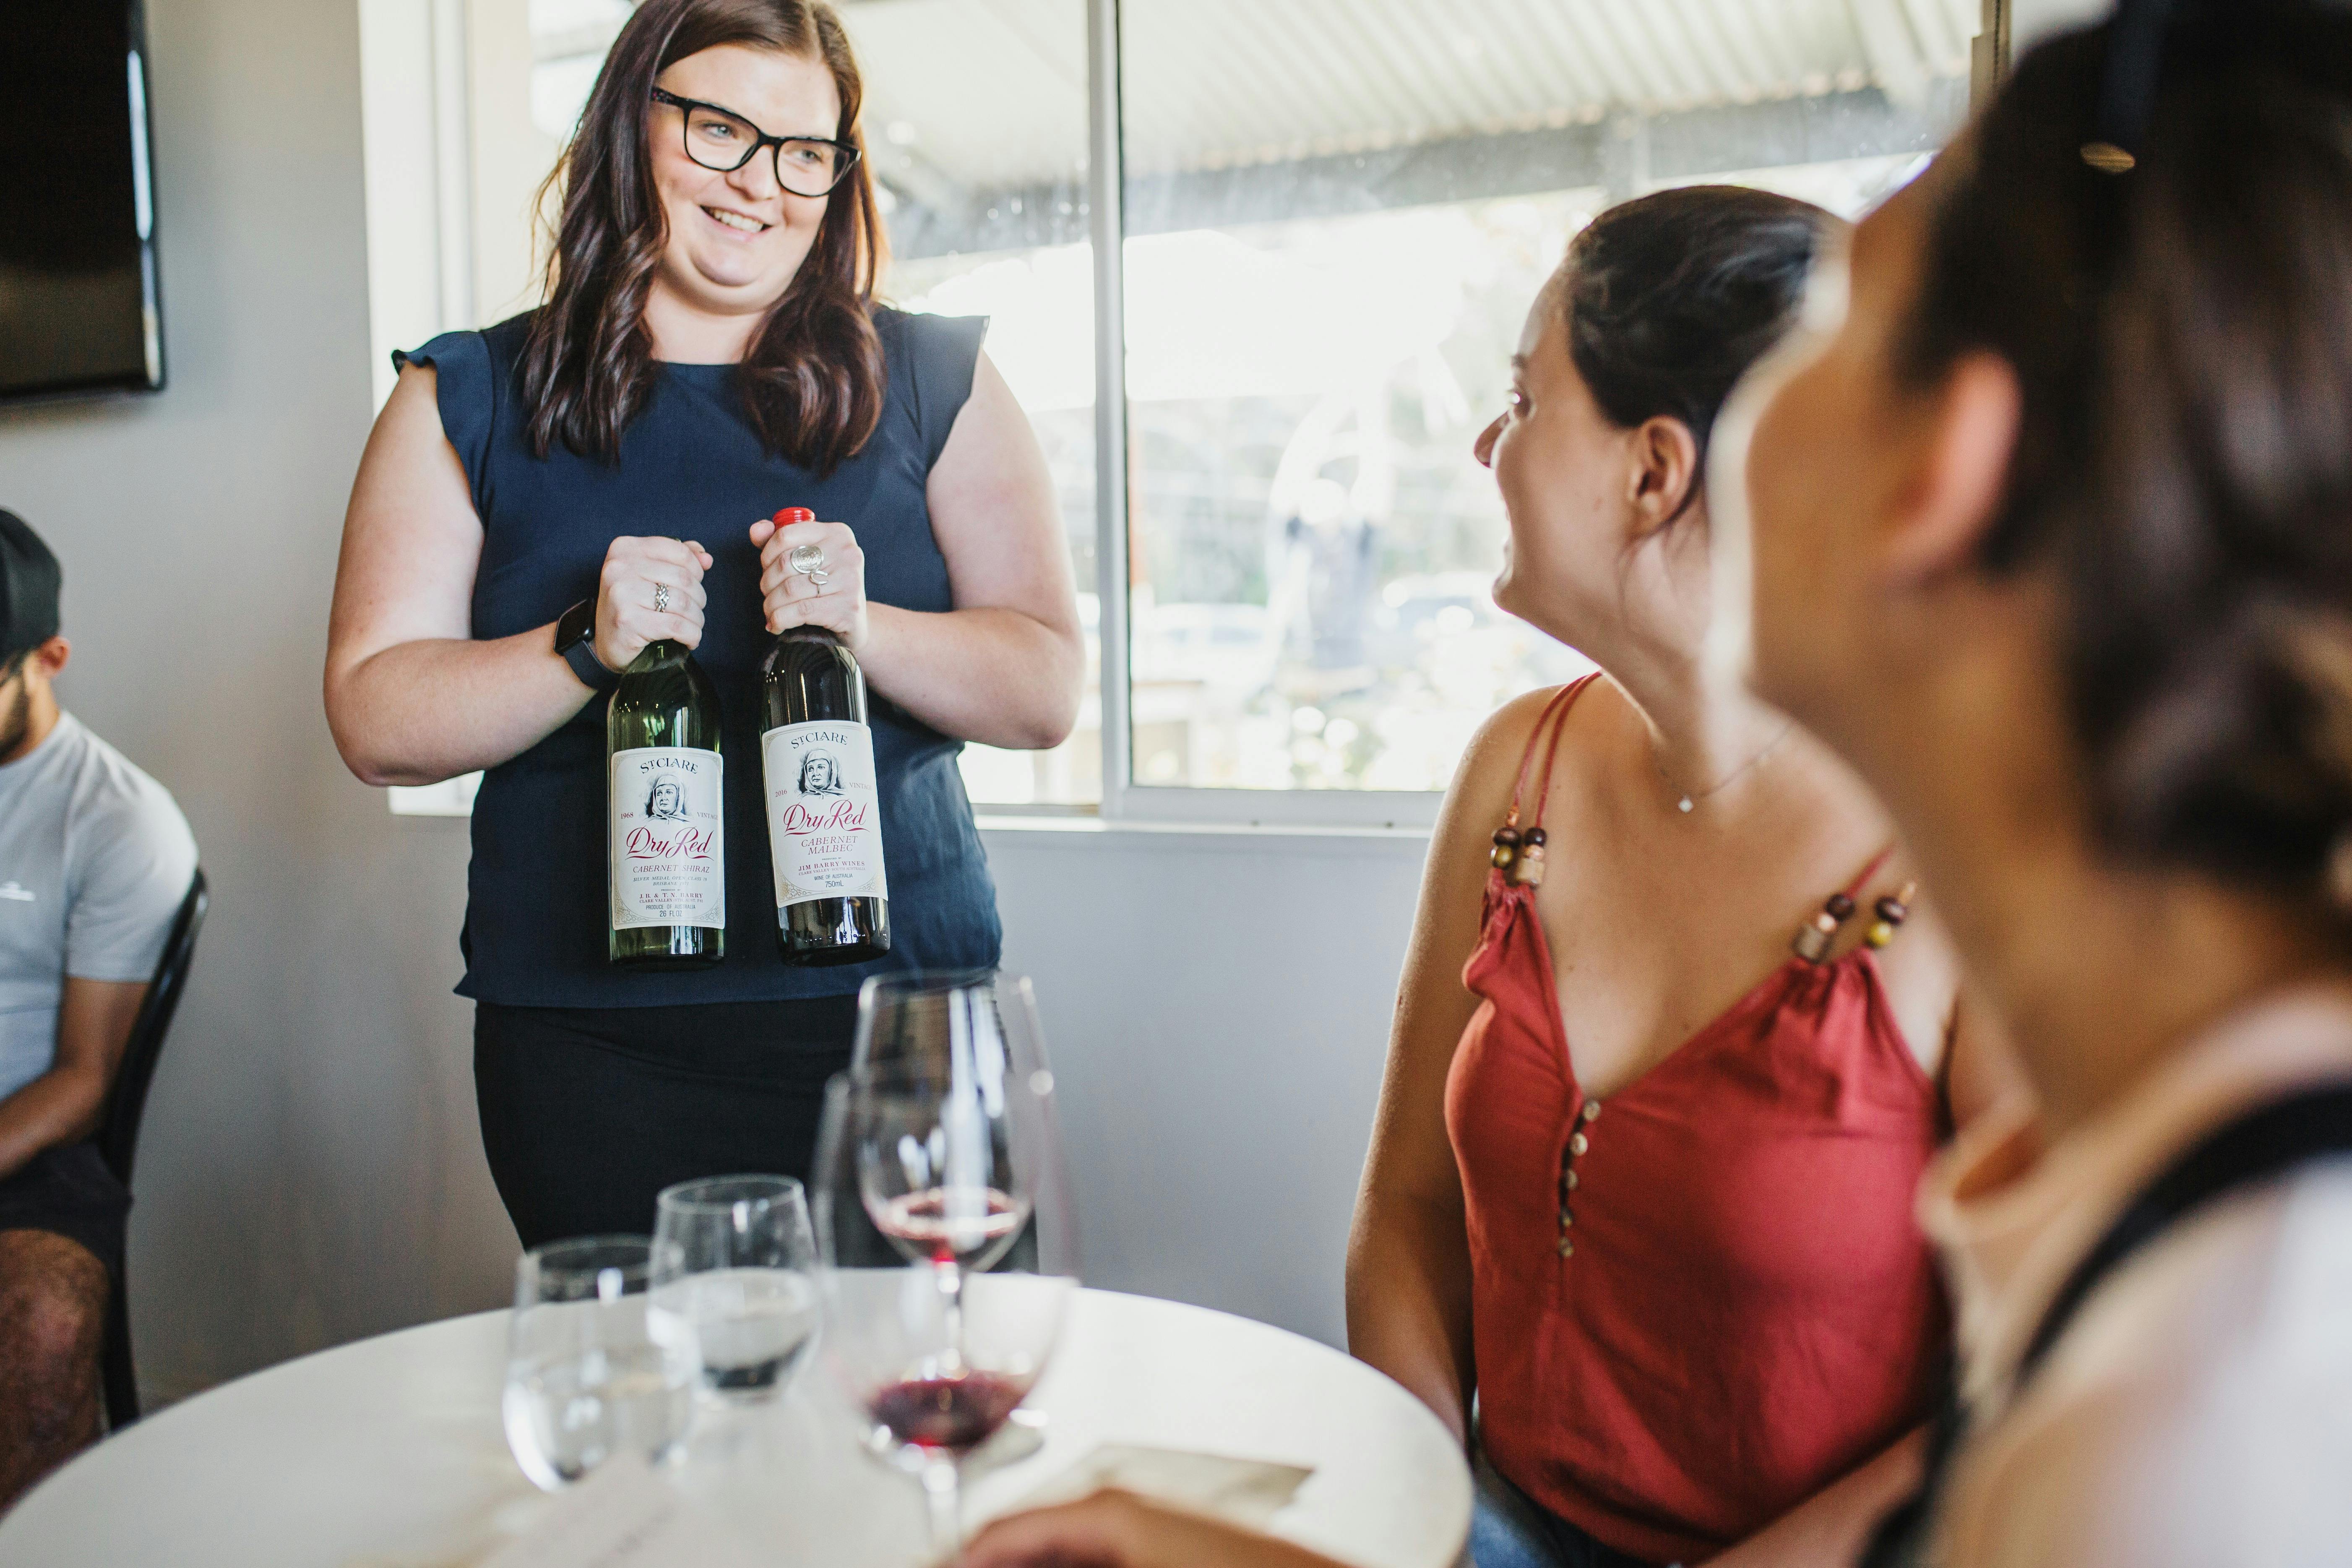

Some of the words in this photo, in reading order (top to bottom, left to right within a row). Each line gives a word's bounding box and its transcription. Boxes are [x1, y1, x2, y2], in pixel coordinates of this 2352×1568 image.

[775, 789, 787, 797] 2016
[783, 802, 824, 837] Dry
[824, 799, 870, 833] Red
[625, 825, 669, 860] Dry
[665, 826, 714, 861] Red
[801, 836, 858, 847] CABERNET
[808, 844, 853, 855] MALBEC
[682, 865, 710, 873] SHIRAZ
